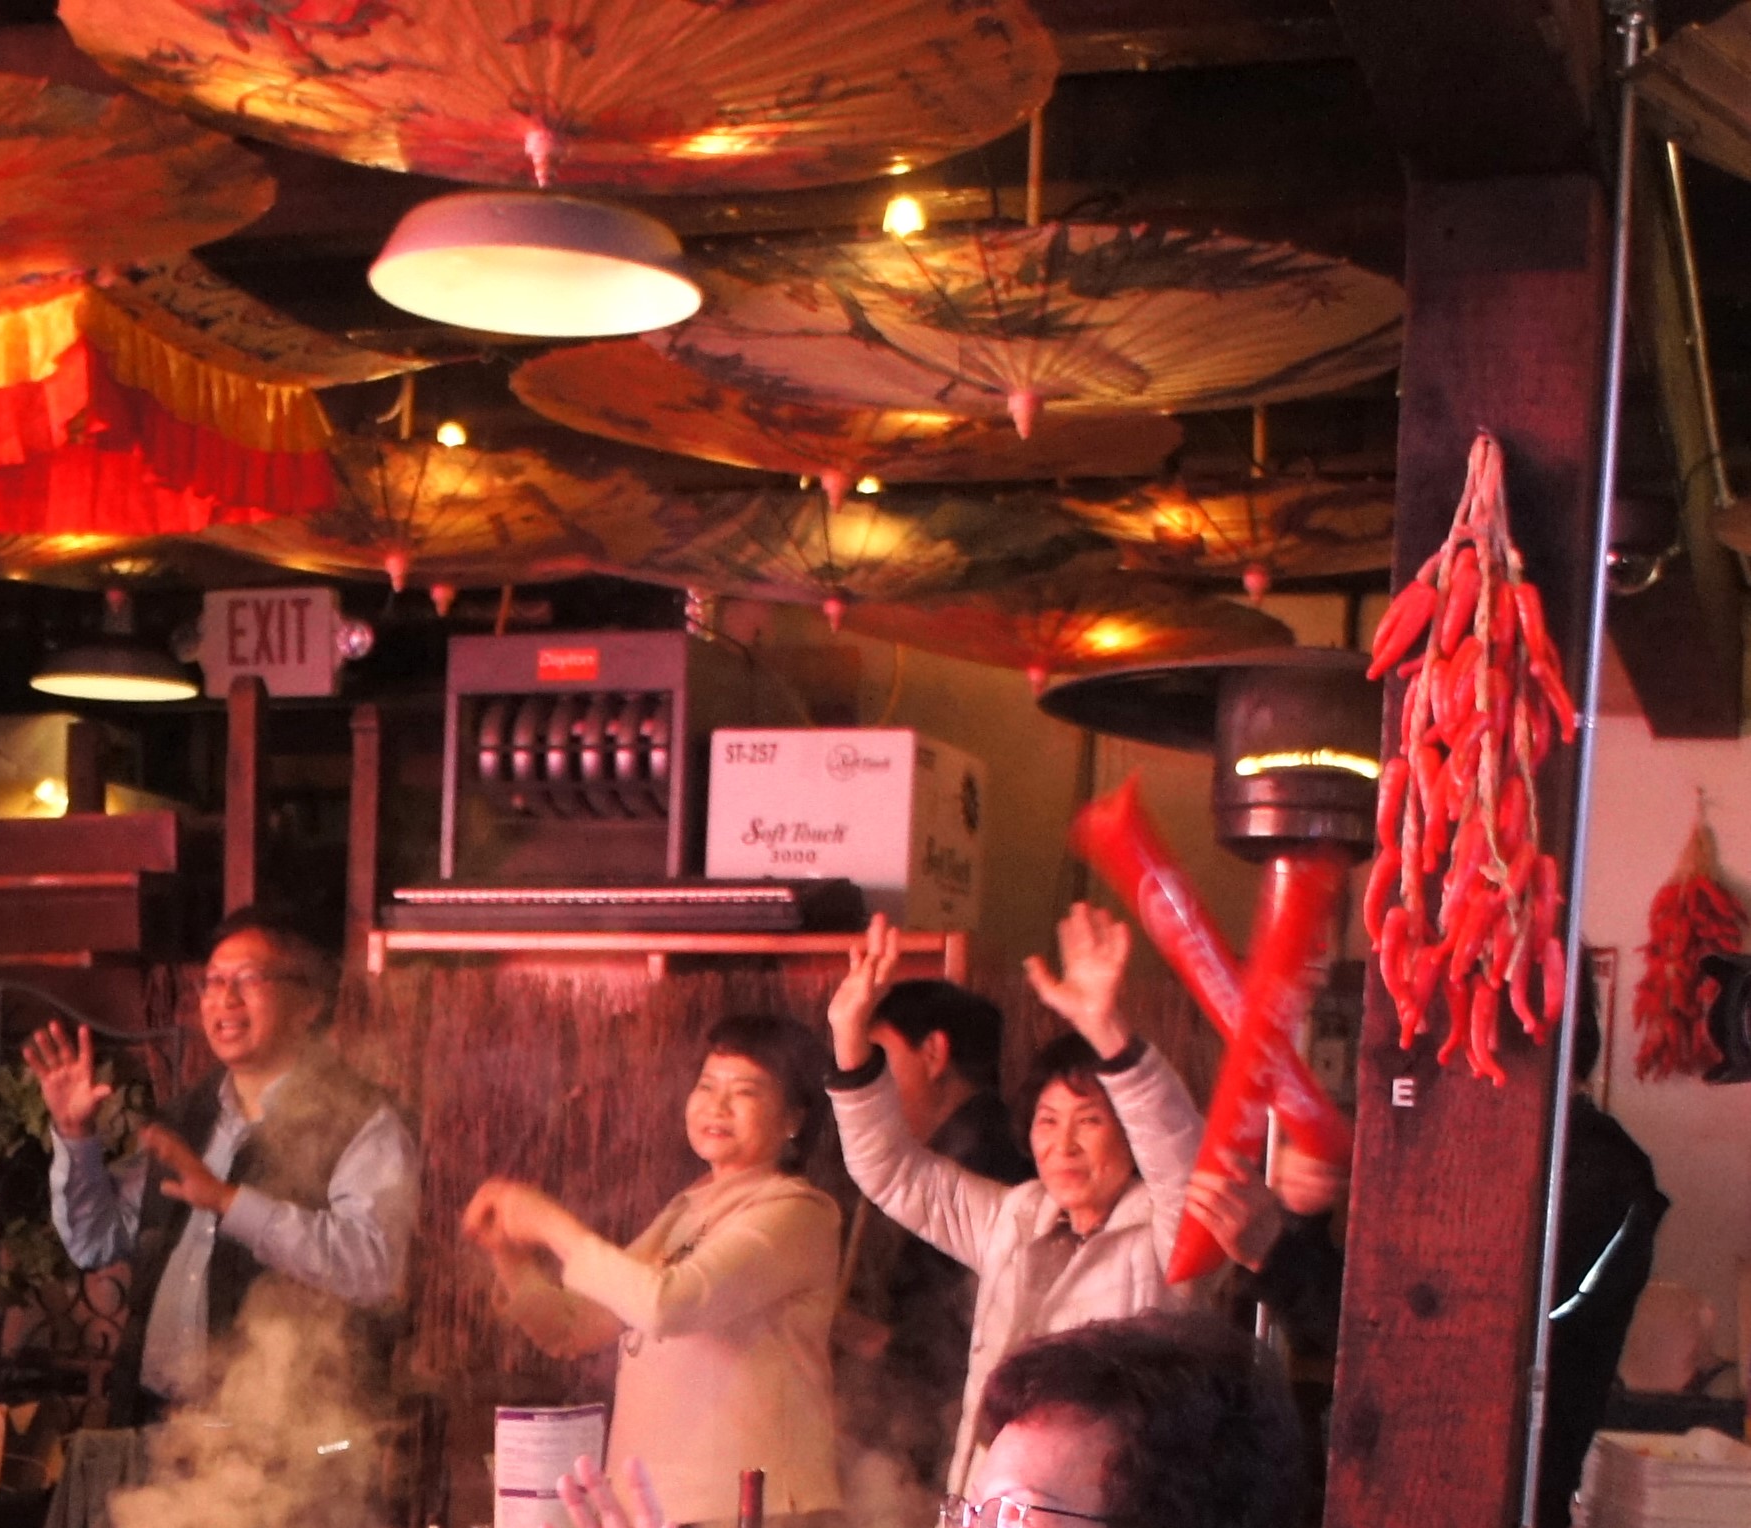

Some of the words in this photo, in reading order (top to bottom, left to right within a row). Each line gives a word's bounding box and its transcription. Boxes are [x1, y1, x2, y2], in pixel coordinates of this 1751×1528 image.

[227, 598, 312, 666] EXIT
[725, 743, 778, 765] ST-257
[741, 817, 787, 849] Soft
[792, 822, 847, 844] Touch
[770, 849, 817, 864] 3000
[1392, 1078, 1414, 1107] E
